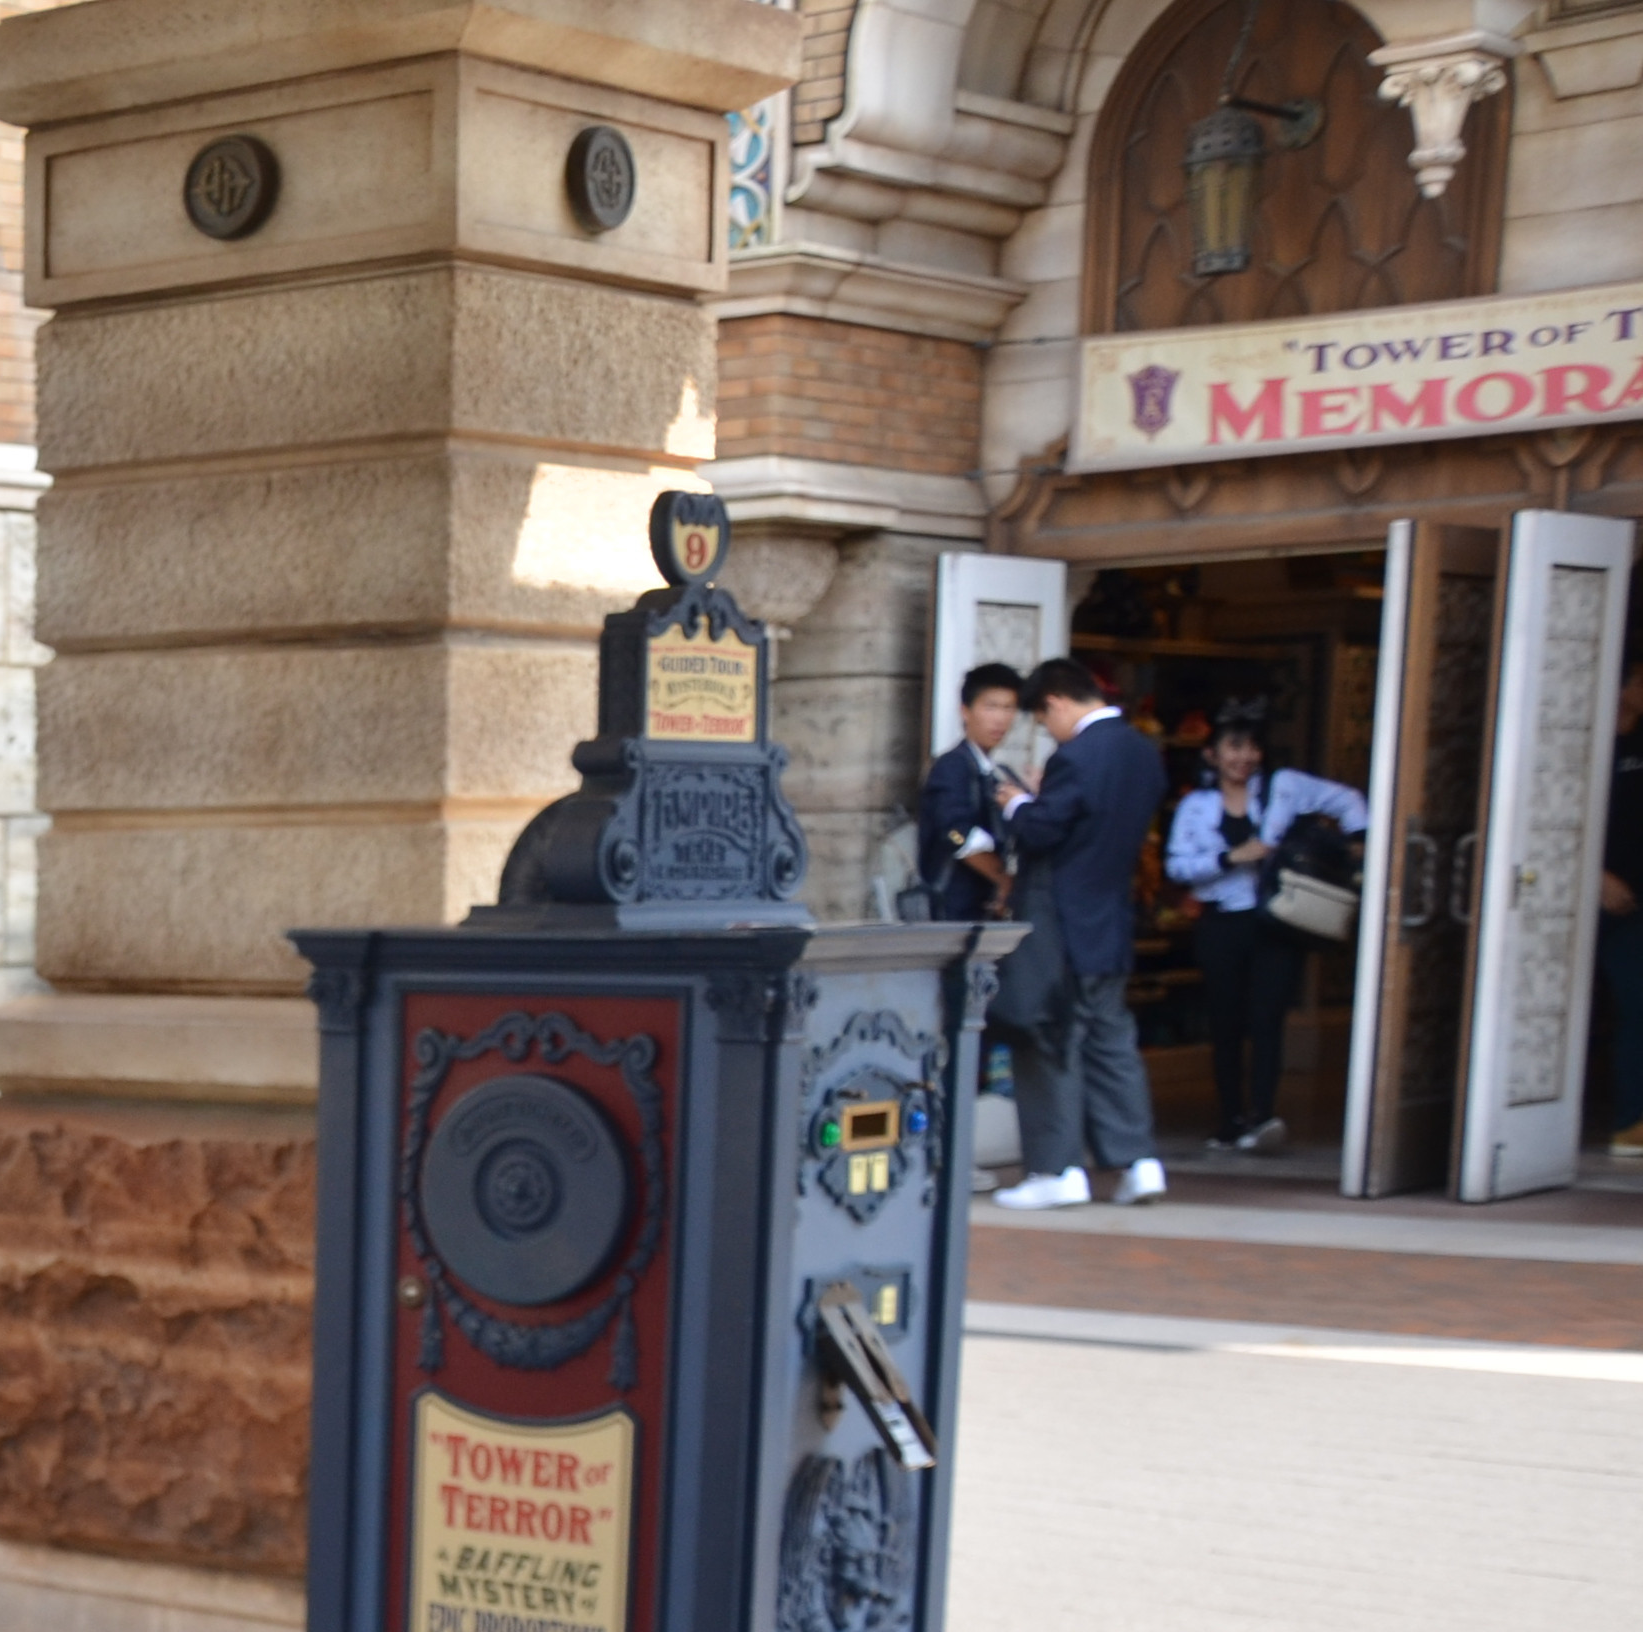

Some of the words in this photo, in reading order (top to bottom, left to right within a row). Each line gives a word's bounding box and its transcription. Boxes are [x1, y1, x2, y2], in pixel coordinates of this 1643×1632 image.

[1282, 329, 1518, 373] "TOWER
[1528, 321, 1593, 347] OF
[685, 532, 708, 570] 9
[582, 1463, 613, 1488] OF
[455, 1546, 602, 1588] BAFFLING
[438, 1572, 577, 1615] MYSTERY
